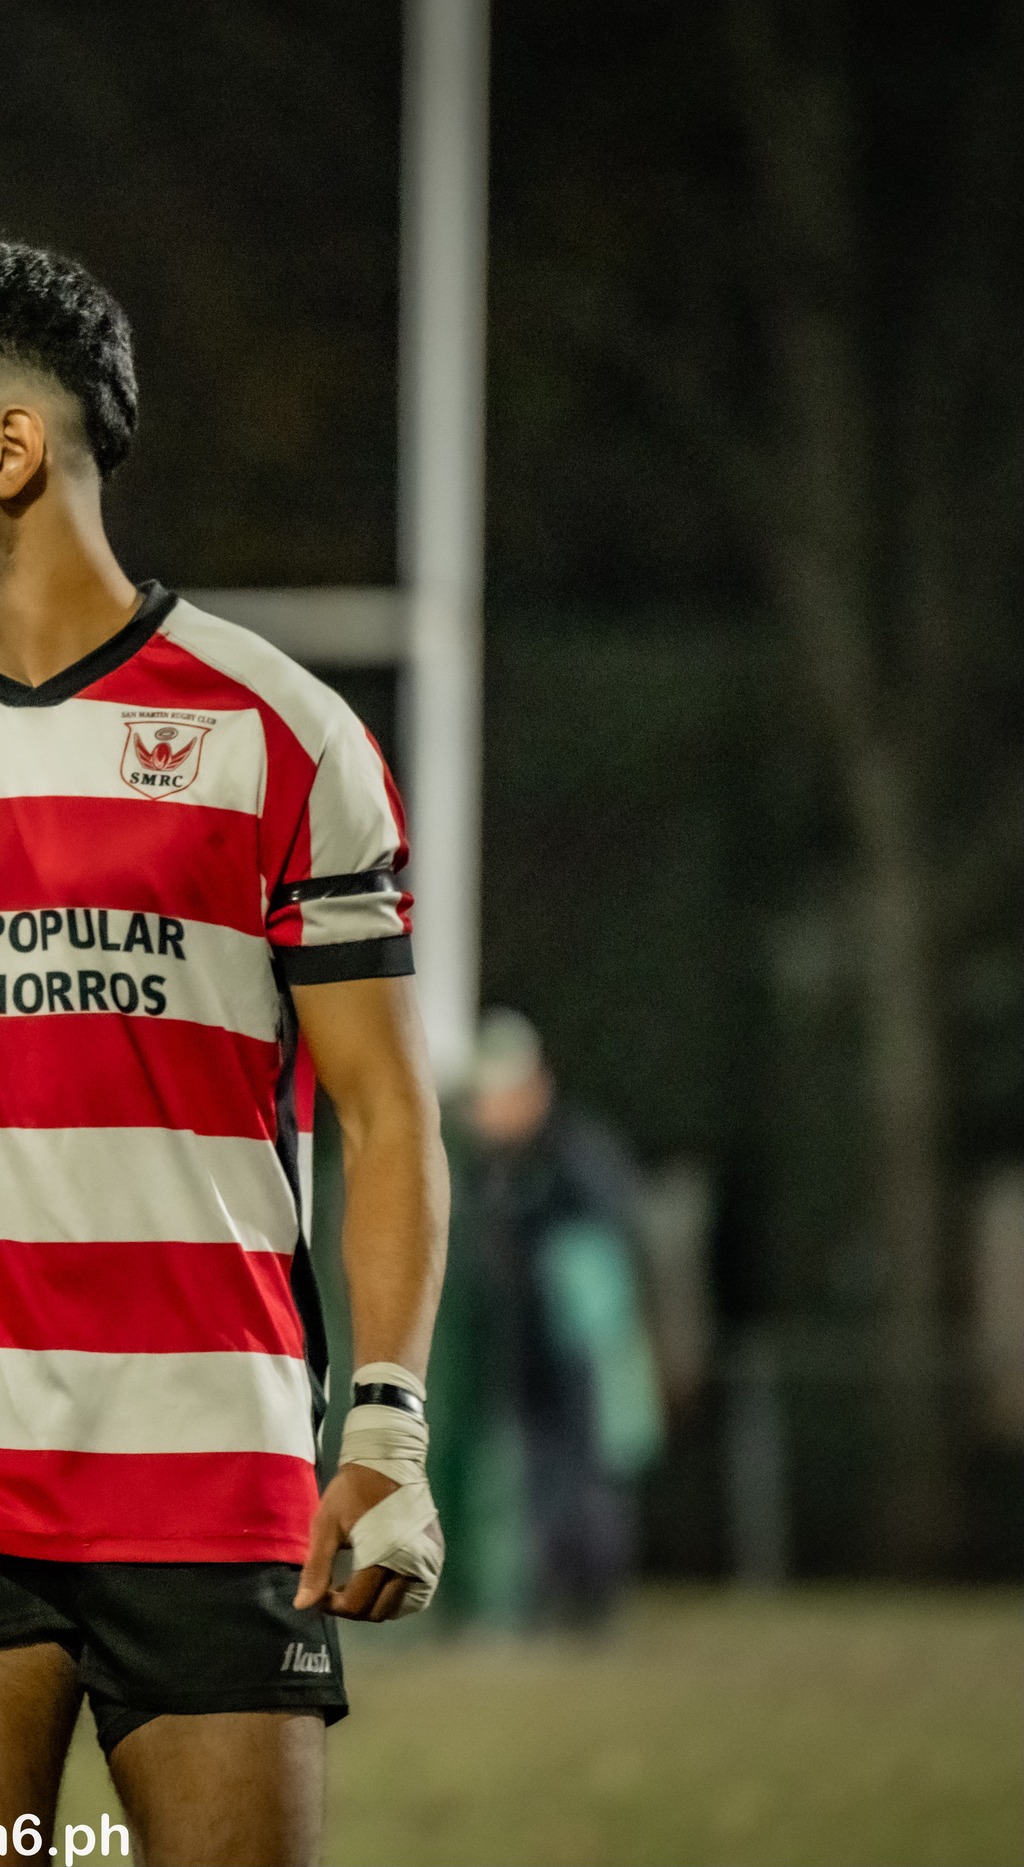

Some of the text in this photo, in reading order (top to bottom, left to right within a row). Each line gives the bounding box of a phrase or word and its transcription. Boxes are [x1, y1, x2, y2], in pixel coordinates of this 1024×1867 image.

[170, 712, 196, 721] RUGBY
[197, 715, 217, 725] CLUB
[129, 772, 183, 787] SMRC
